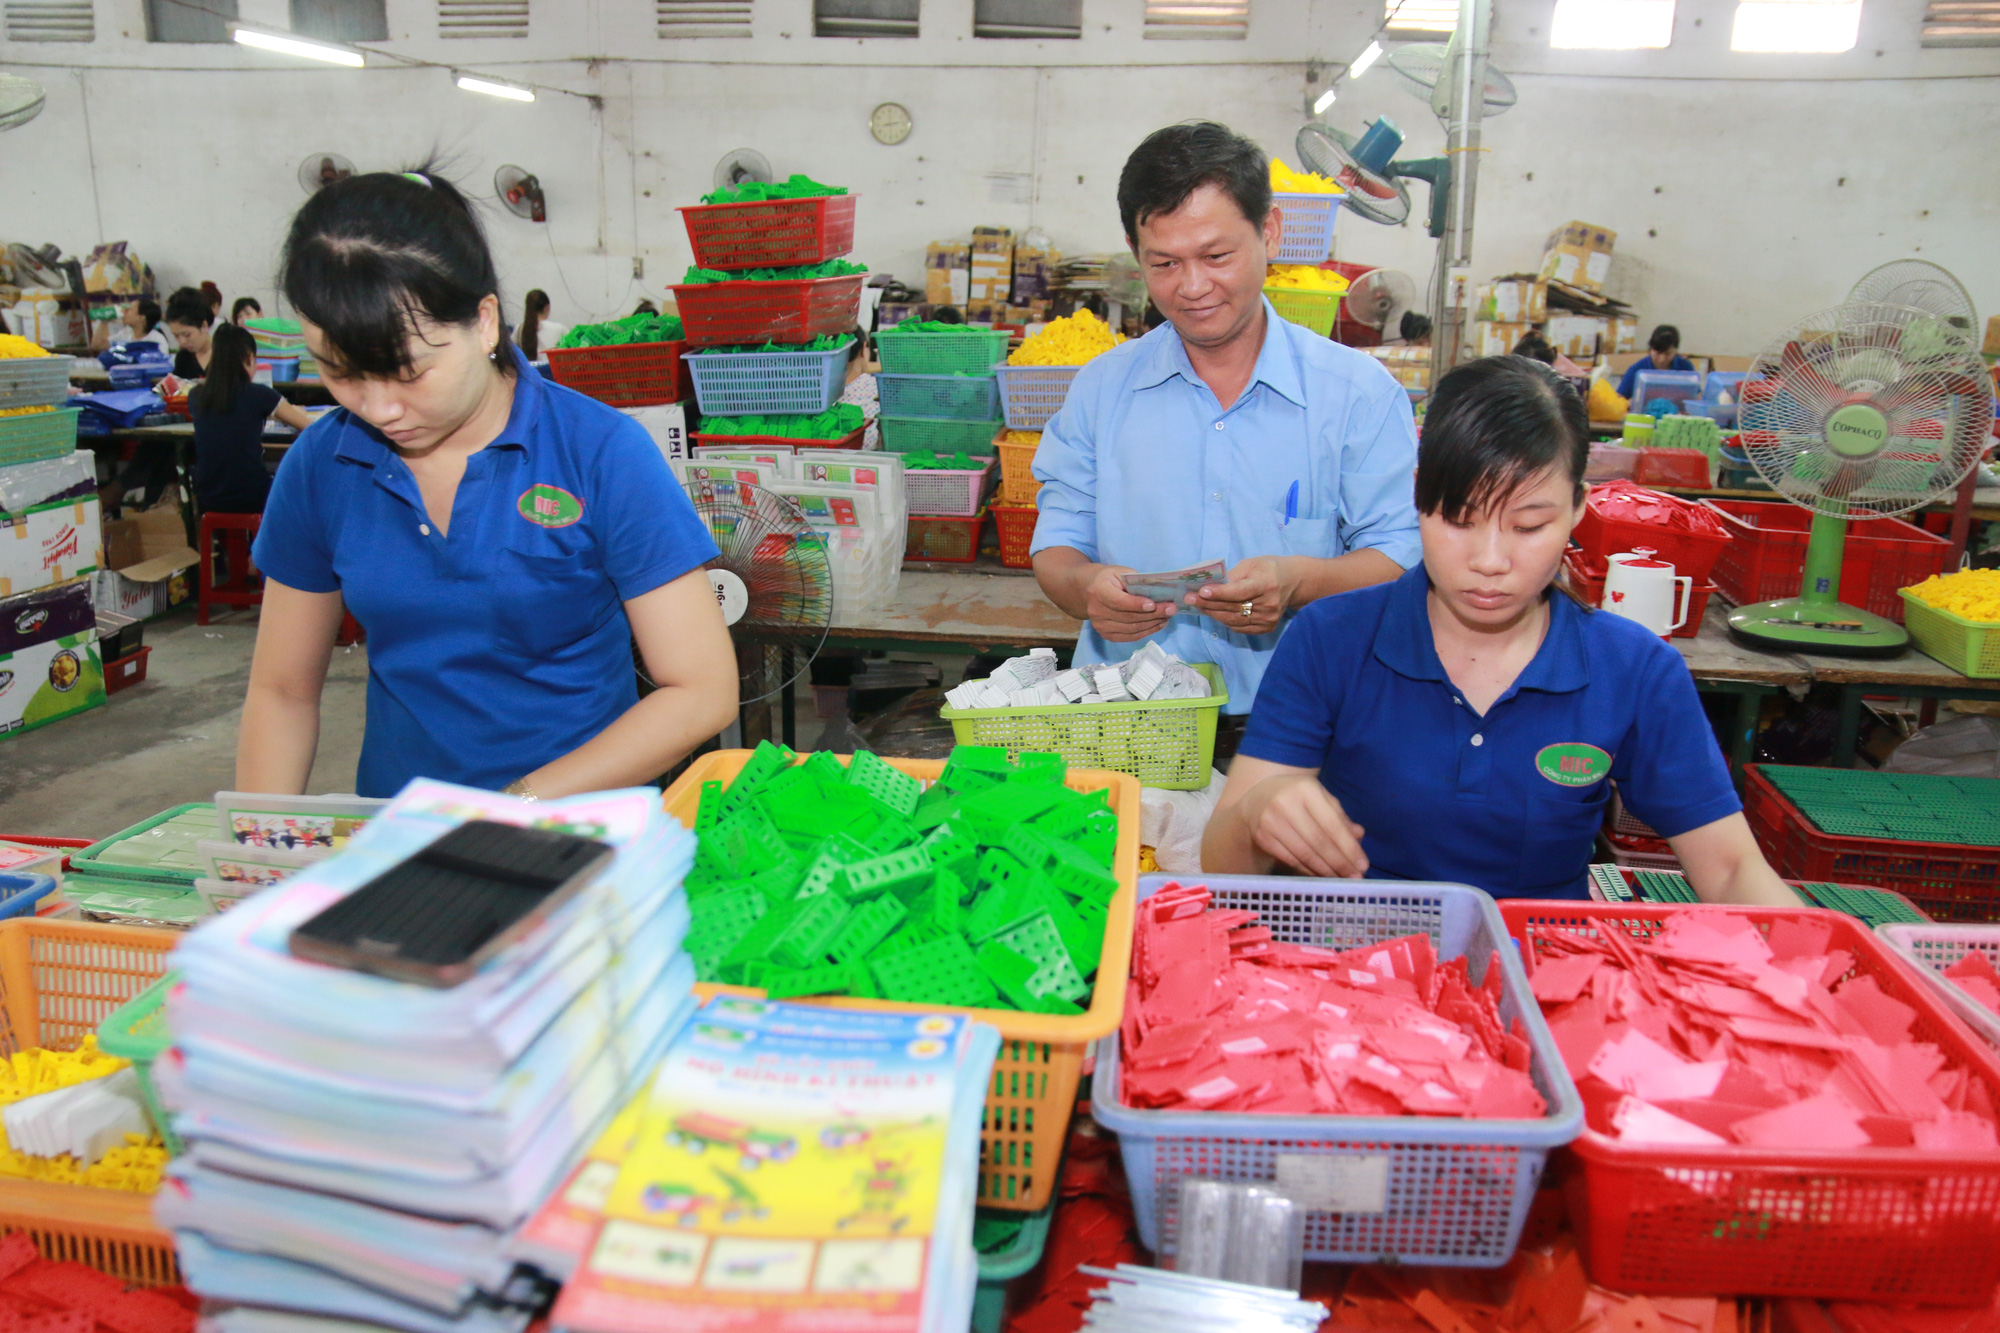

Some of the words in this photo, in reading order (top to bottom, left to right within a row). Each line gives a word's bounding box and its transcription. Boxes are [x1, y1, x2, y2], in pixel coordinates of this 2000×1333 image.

[1833, 421, 1882, 440] COPHACO
[714, 584, 726, 607] gio
[1559, 755, 1593, 774] MIC
